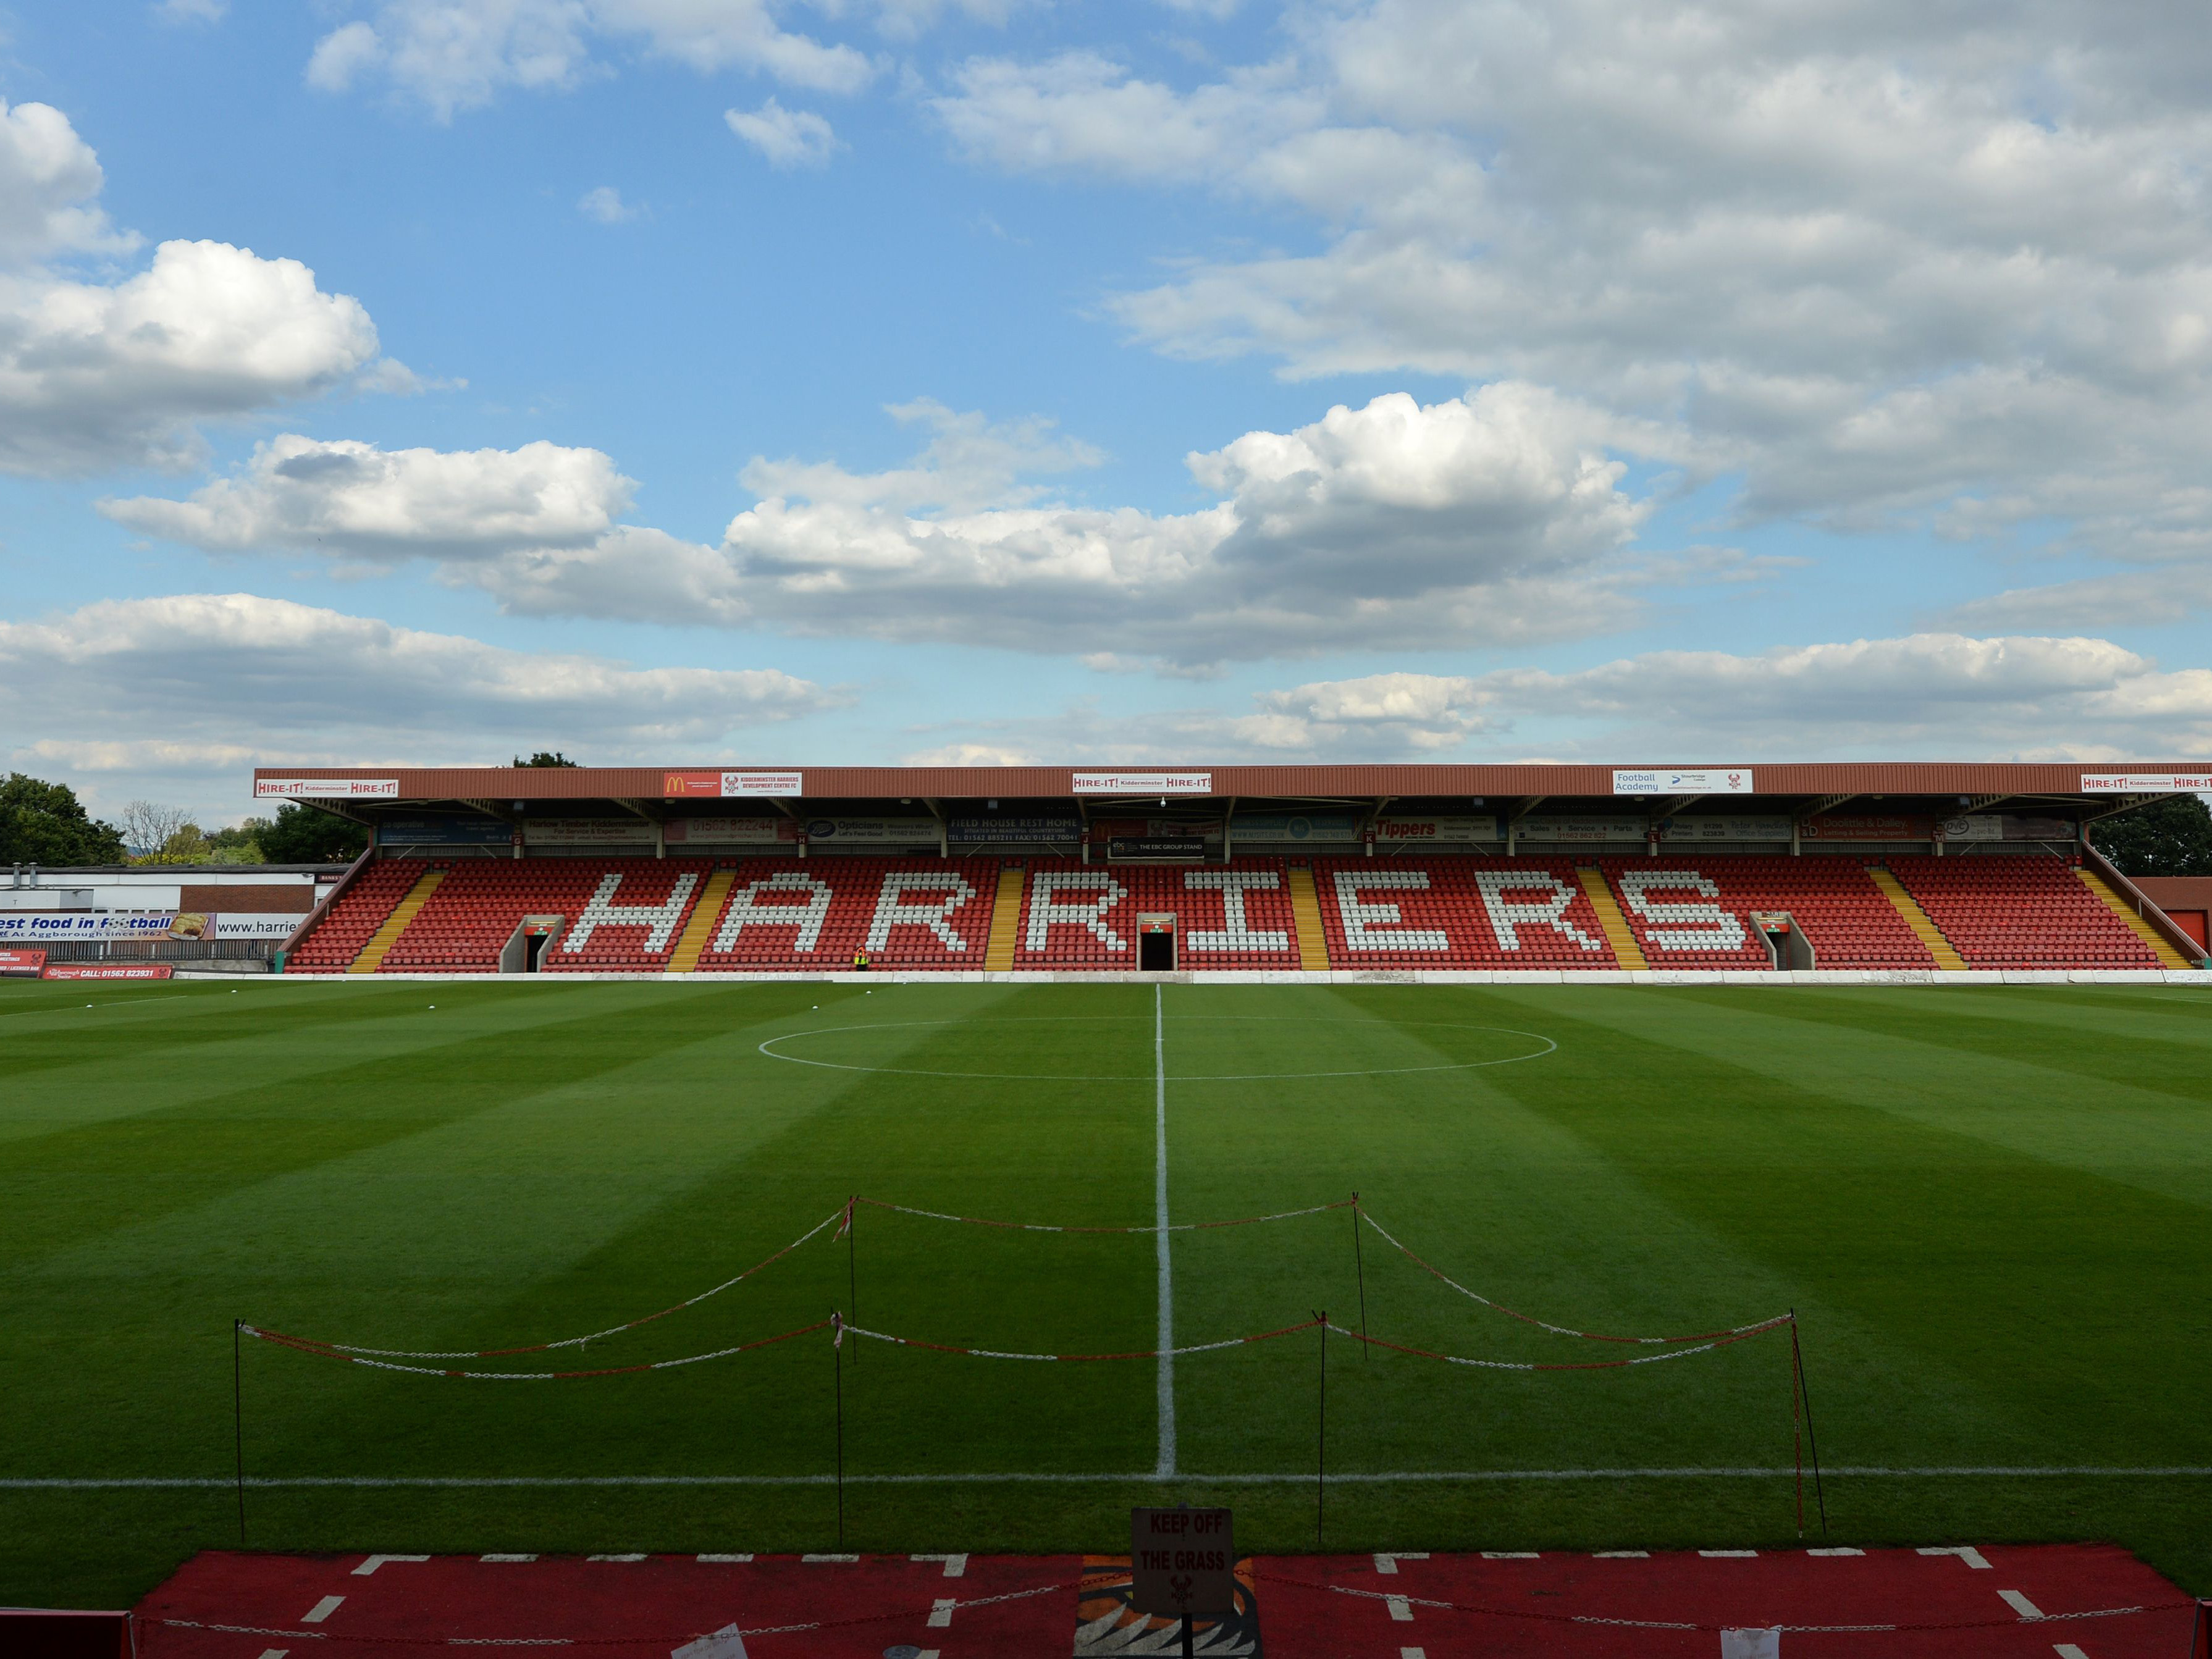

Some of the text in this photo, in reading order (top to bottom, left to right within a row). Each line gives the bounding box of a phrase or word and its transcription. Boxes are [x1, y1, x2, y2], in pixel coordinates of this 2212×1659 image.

[1074, 777, 1119, 788] HIRE-IT!
[1166, 777, 1211, 788] HIRE-IT!
[1618, 773, 1655, 782] Football
[2083, 777, 2128, 789] HIRE-IT!
[258, 782, 304, 794] HIRE-IT!
[351, 782, 397, 794] HIRE-IT!
[1615, 783, 1659, 792] Academy
[529, 820, 650, 828] Harlow Timber Kidderminster
[693, 818, 773, 831] 01562 822244
[838, 821, 883, 831] Opticians
[951, 819, 1078, 828] FIELD HOUSE REST HOME
[1731, 820, 1751, 829] Peter
[1823, 818, 1864, 828] Doolittle
[1866, 818, 1875, 828] &
[1877, 818, 1907, 829] Dalley.
[1946, 820, 1966, 830] pvc
[1376, 820, 1436, 839] Tippers
[1809, 826, 1819, 837] D
[1112, 841, 1124, 849] ebc
[563, 873, 1746, 952] HARRIERS
[31, 918, 73, 930] food
[78, 918, 95, 930] in
[100, 918, 171, 930] football
[217, 921, 302, 933] www.harrie
[28, 931, 103, 939] Aggborough
[80, 970, 101, 978] CALL:
[126, 969, 154, 977] 823931
[1151, 1514, 1222, 1533] KEEP OFF
[1140, 1550, 1225, 1571] THE GRASS
